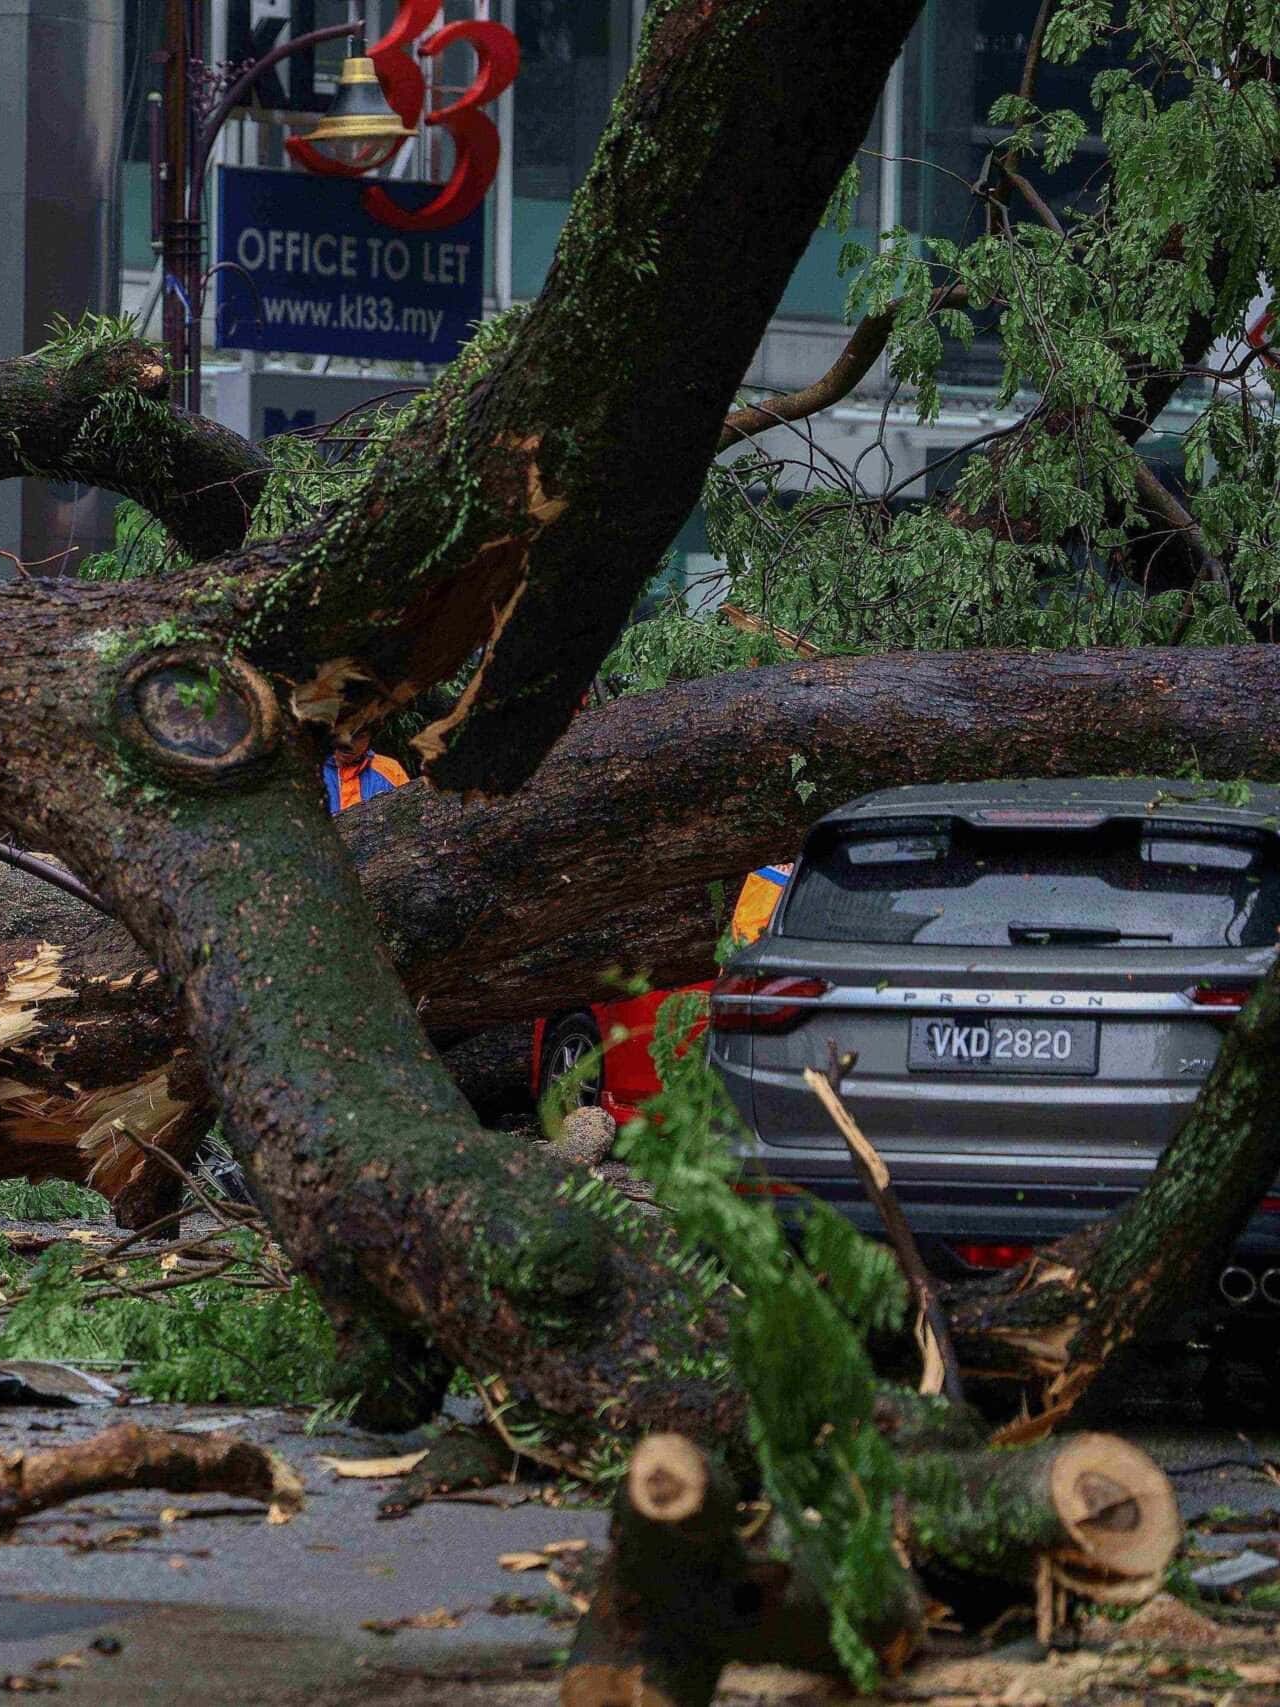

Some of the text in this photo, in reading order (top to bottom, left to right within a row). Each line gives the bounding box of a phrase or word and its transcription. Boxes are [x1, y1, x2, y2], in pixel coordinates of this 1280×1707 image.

[237, 228, 469, 285] OFFICE TO LET
[264, 294, 444, 343] www.kl33.my
[904, 992, 1103, 1006] PROTON
[933, 1026, 1071, 1059] VKD 2820
